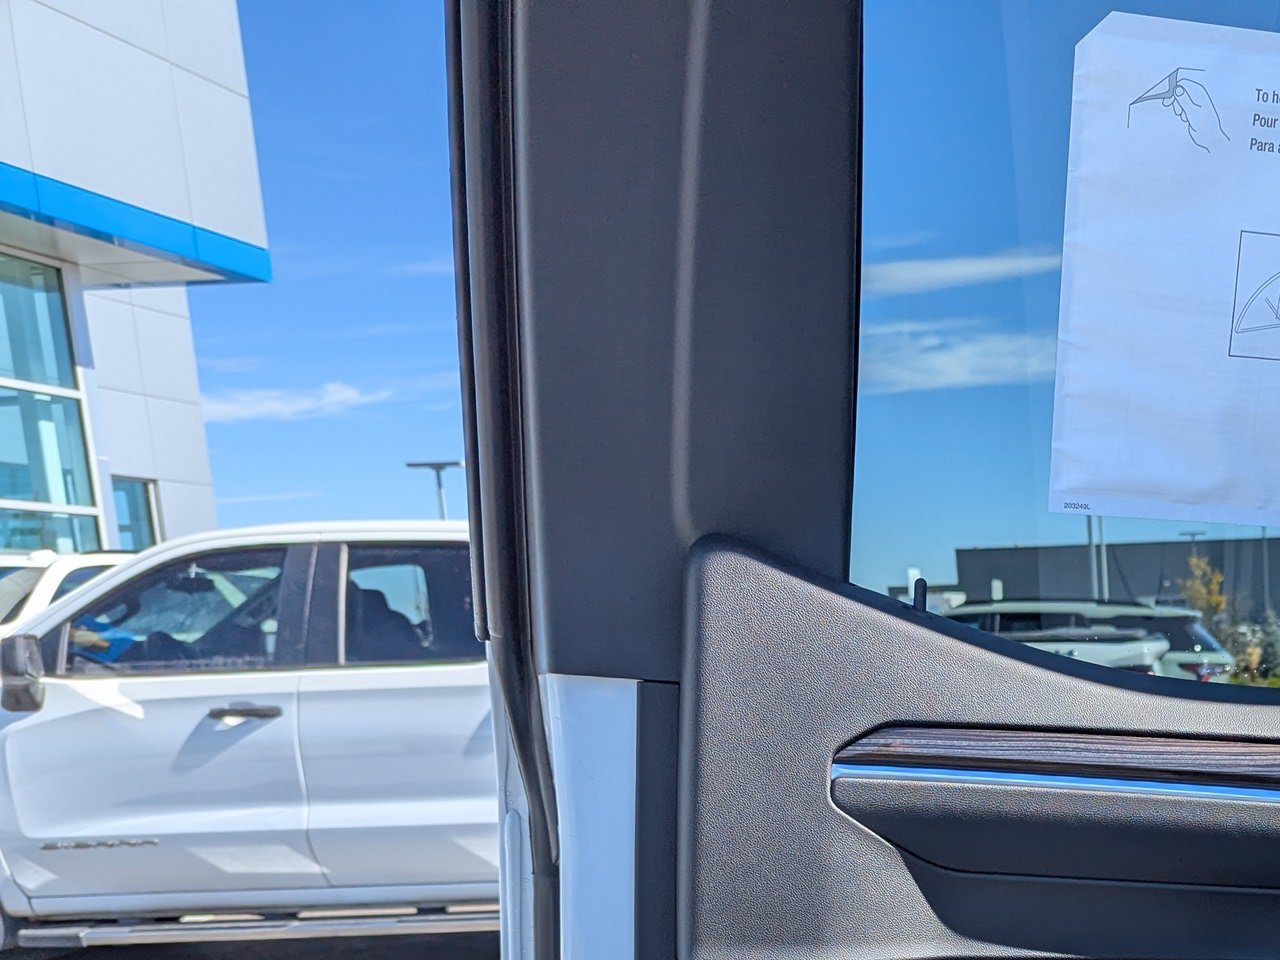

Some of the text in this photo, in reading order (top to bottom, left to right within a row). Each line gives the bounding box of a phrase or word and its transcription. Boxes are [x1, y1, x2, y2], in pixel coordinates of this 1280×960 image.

[1255, 88, 1269, 103] To
[1252, 113, 1278, 129] Pour
[1249, 137, 1275, 153] Para
